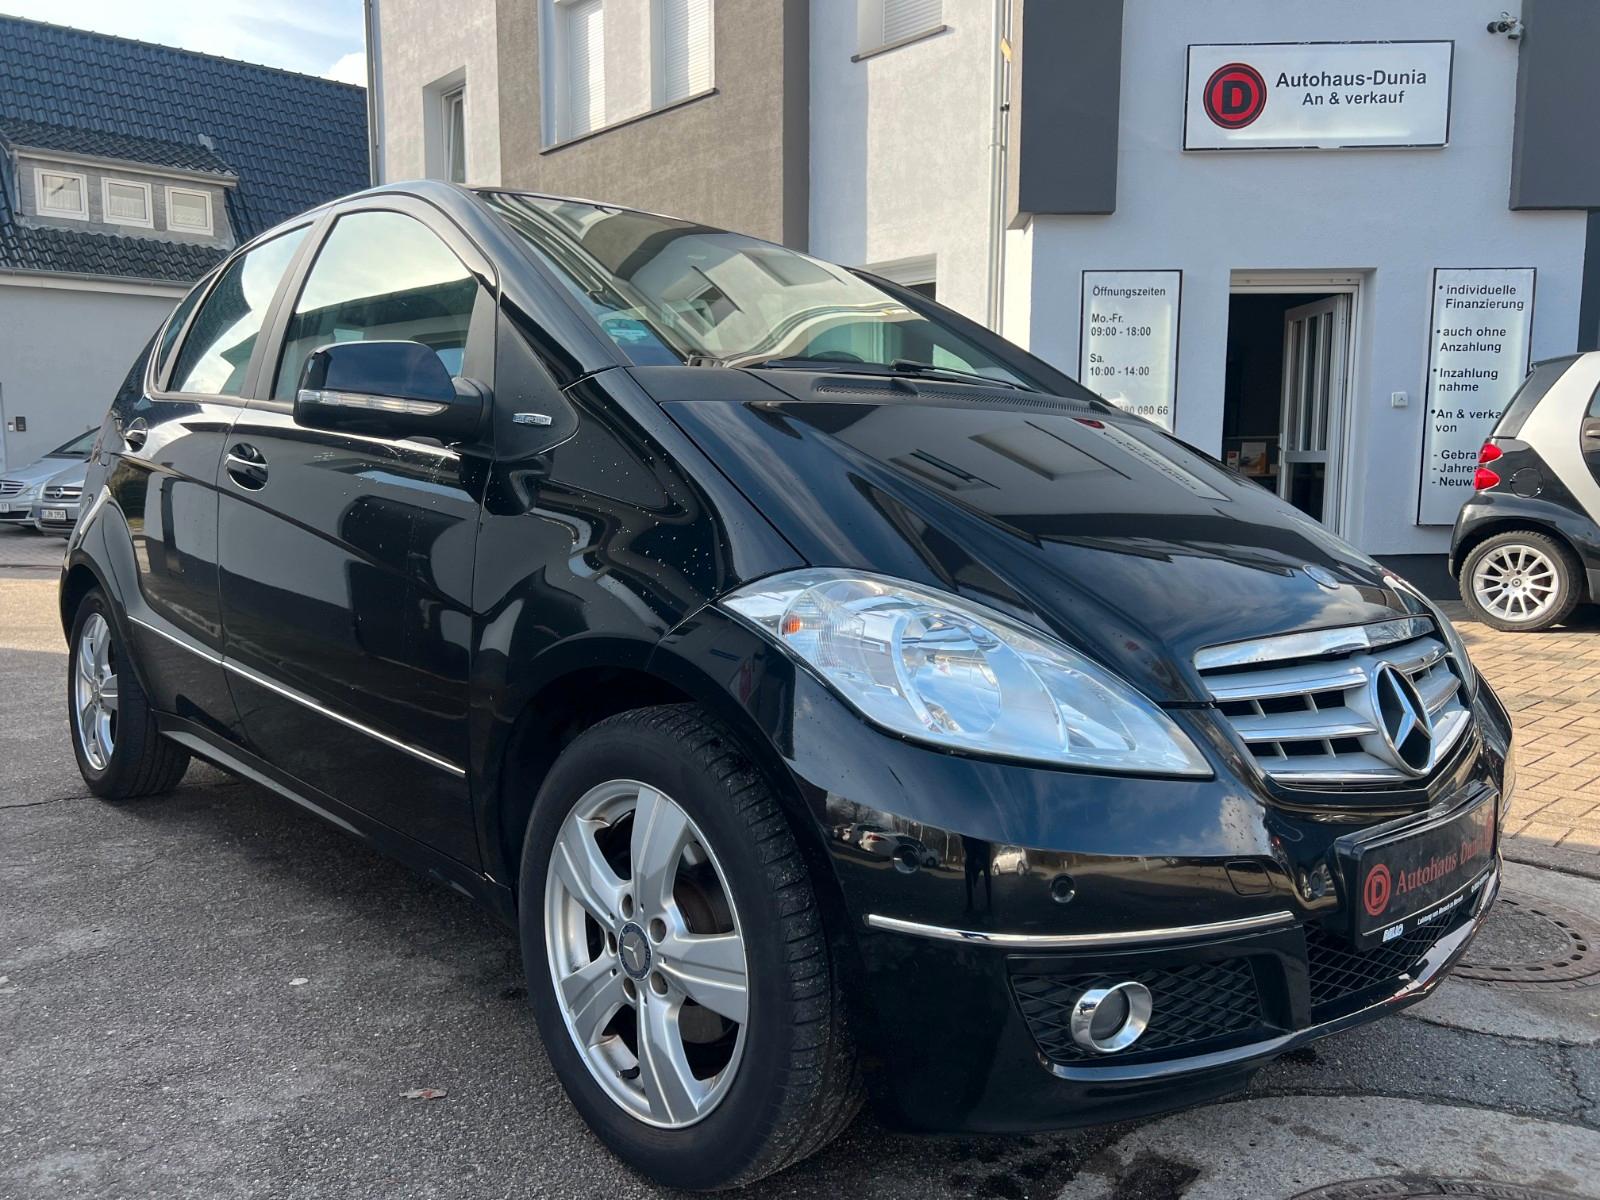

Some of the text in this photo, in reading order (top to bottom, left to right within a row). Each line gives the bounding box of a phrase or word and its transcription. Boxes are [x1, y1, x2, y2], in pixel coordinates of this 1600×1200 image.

[1276, 69, 1427, 88] Autohaus-Dunia
[1221, 79, 1252, 114] D
[1302, 90, 1405, 106] An & verkauf
[1092, 285, 1166, 299] Öffnungszeiten
[1446, 284, 1516, 295] individuelle
[1445, 299, 1524, 311] Finanzierung
[1091, 313, 1124, 323] Mo.-Fr.
[1091, 326, 1117, 336] 09:00
[1126, 326, 1152, 336] 18:00
[1443, 327, 1507, 337] auch ohne
[1440, 342, 1502, 353] Anzahlung
[1090, 353, 1105, 363] Sa.
[1090, 366, 1115, 376] 10:00
[1125, 366, 1150, 376] 14:00
[1440, 368, 1498, 380] Inzahlung
[1439, 382, 1479, 392] nahme
[1157, 405, 1169, 415] 66
[1436, 409, 1502, 419] An & verka
[1435, 424, 1457, 432] von
[1441, 449, 1477, 460] Gebra
[1440, 463, 1478, 473] Jahres
[1439, 476, 1475, 486] Neuw
[1396, 852, 1457, 896] Autohaus
